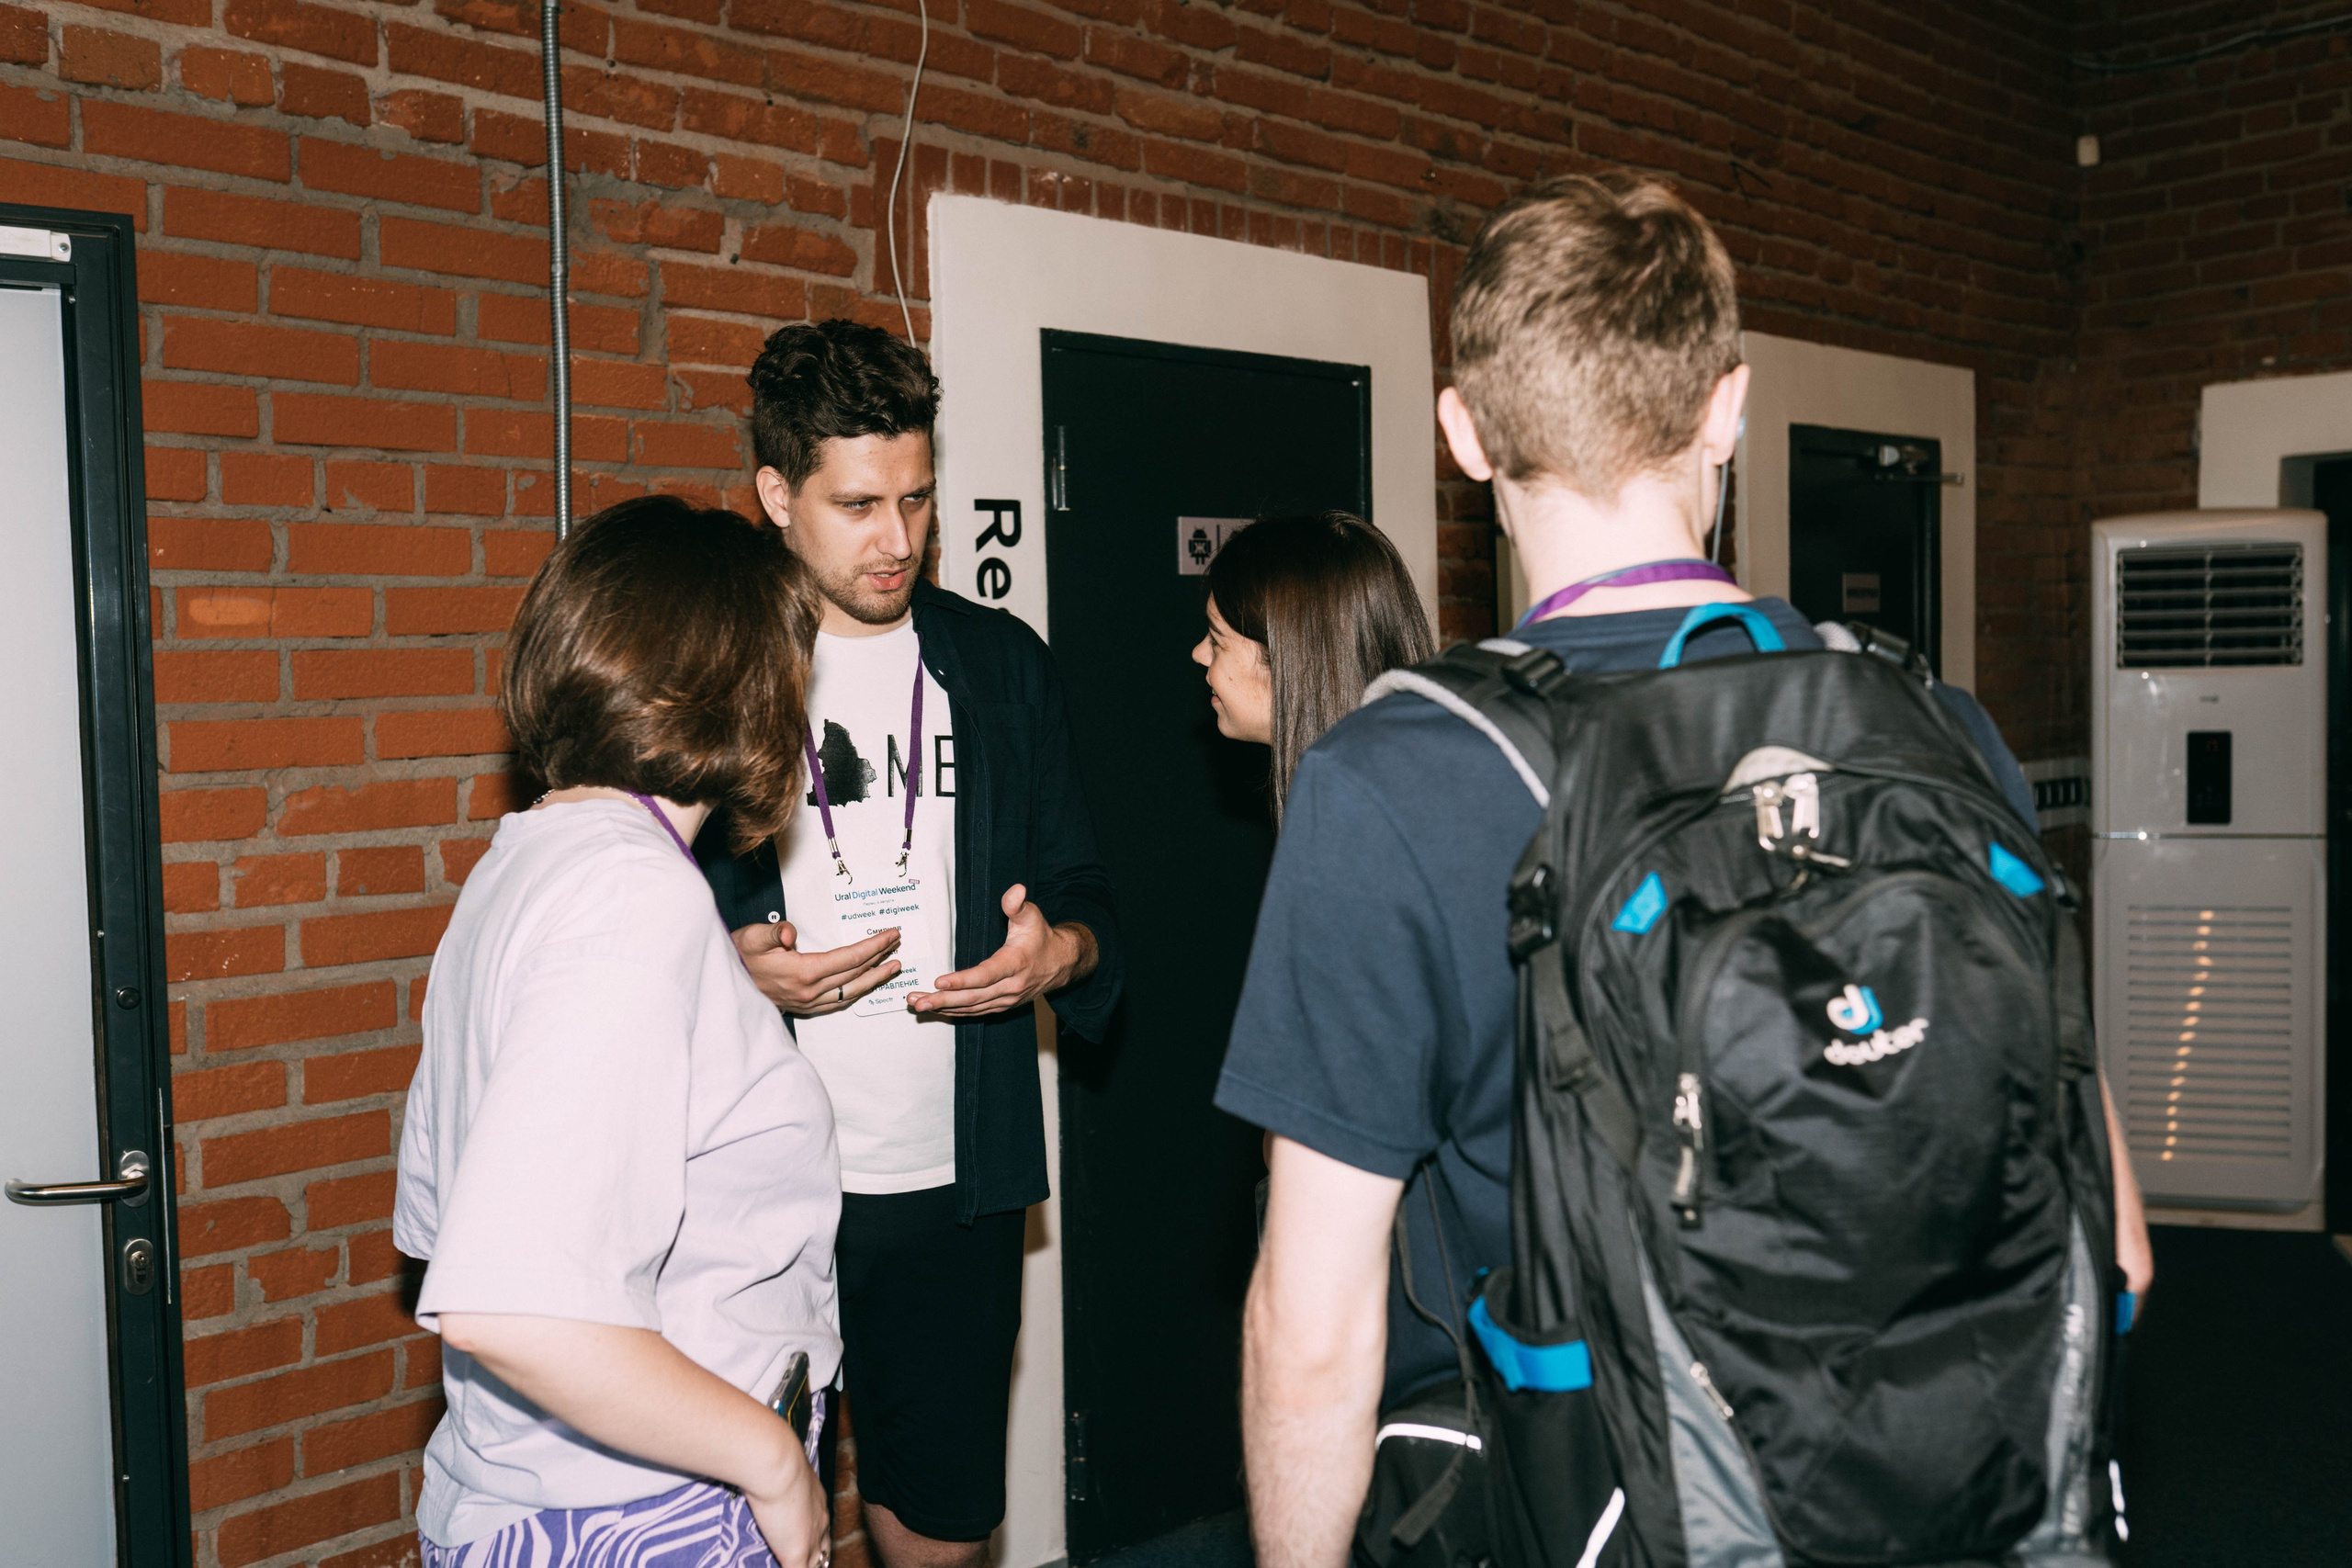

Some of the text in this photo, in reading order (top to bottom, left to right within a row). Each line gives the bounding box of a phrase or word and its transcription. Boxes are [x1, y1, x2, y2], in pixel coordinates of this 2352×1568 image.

[974, 499, 1022, 612] Re
[834, 884, 917, 902] Ural Digital Weekend
[841, 904, 920, 920] #udweek #digiweek
